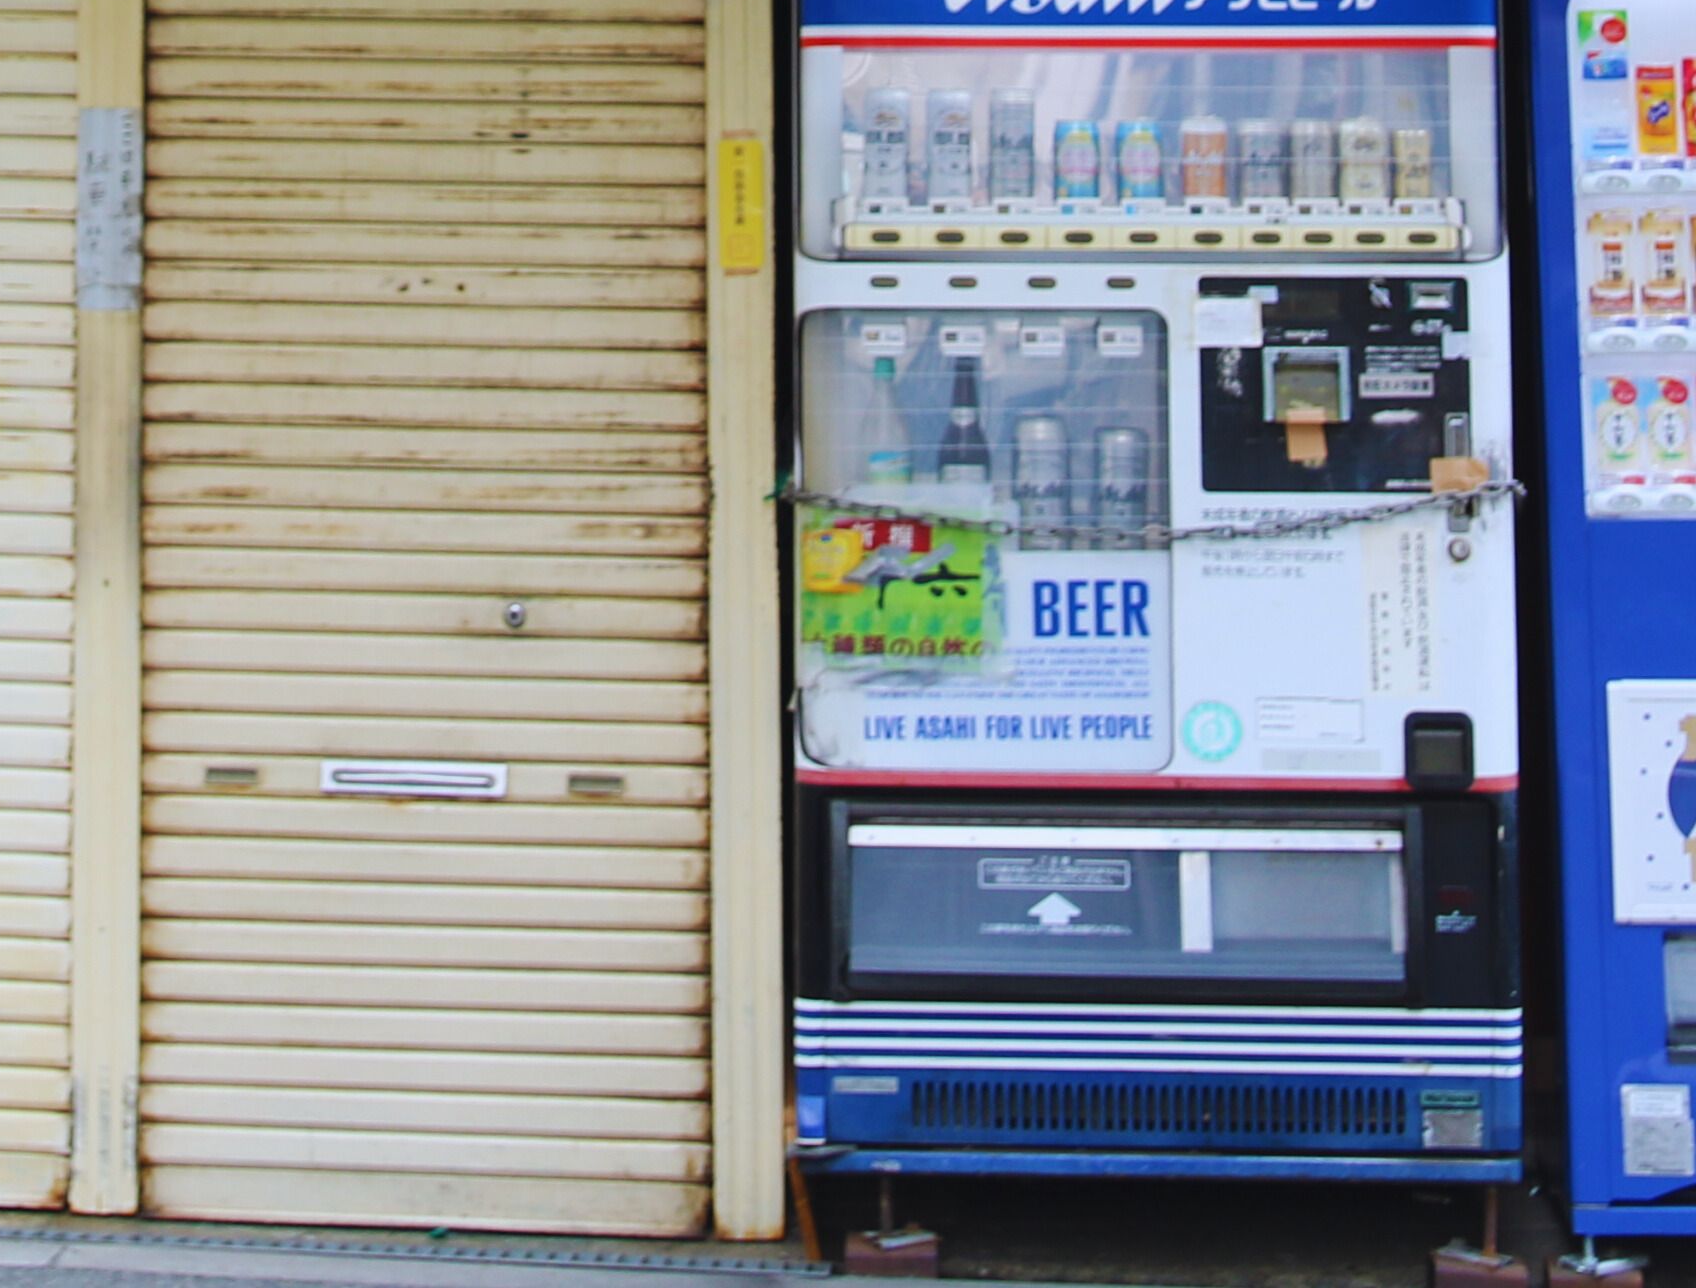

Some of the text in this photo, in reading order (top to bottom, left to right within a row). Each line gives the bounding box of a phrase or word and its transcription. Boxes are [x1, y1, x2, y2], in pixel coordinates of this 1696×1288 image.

[1033, 581, 1150, 638] BEER
[864, 715, 906, 740] LIVE
[915, 715, 977, 740] ASAHI
[985, 715, 1023, 740] FOR
[1030, 715, 1072, 740] LIVE
[1080, 715, 1153, 740] PEOPLE
